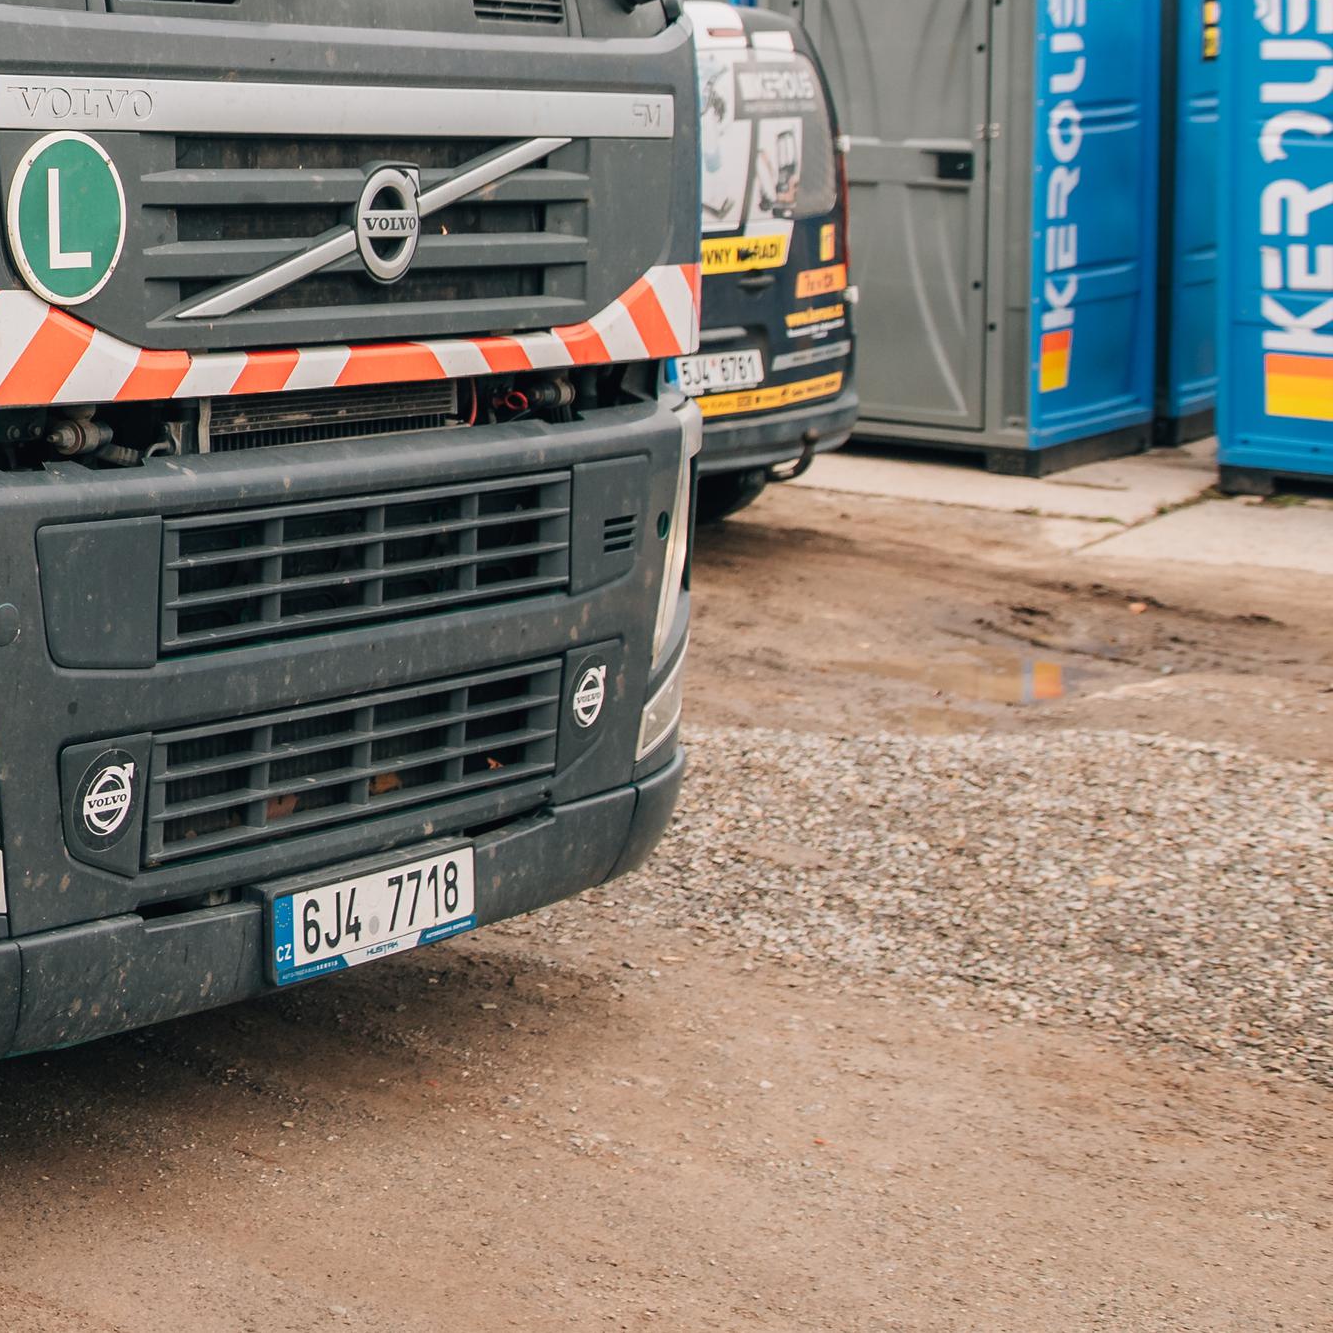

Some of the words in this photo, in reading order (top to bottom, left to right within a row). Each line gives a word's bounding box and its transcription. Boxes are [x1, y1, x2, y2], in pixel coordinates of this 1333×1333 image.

[7, 85, 155, 120] VOLVO
[48, 167, 92, 270] L
[363, 215, 417, 232] VOLVO
[701, 250, 731, 267] VNY
[681, 357, 710, 386] 5J4
[720, 354, 757, 381] 6761
[87, 793, 127, 809] VOLVO
[302, 886, 362, 955] 6J4
[387, 860, 458, 933] 7718
[276, 943, 292, 963] CZ
